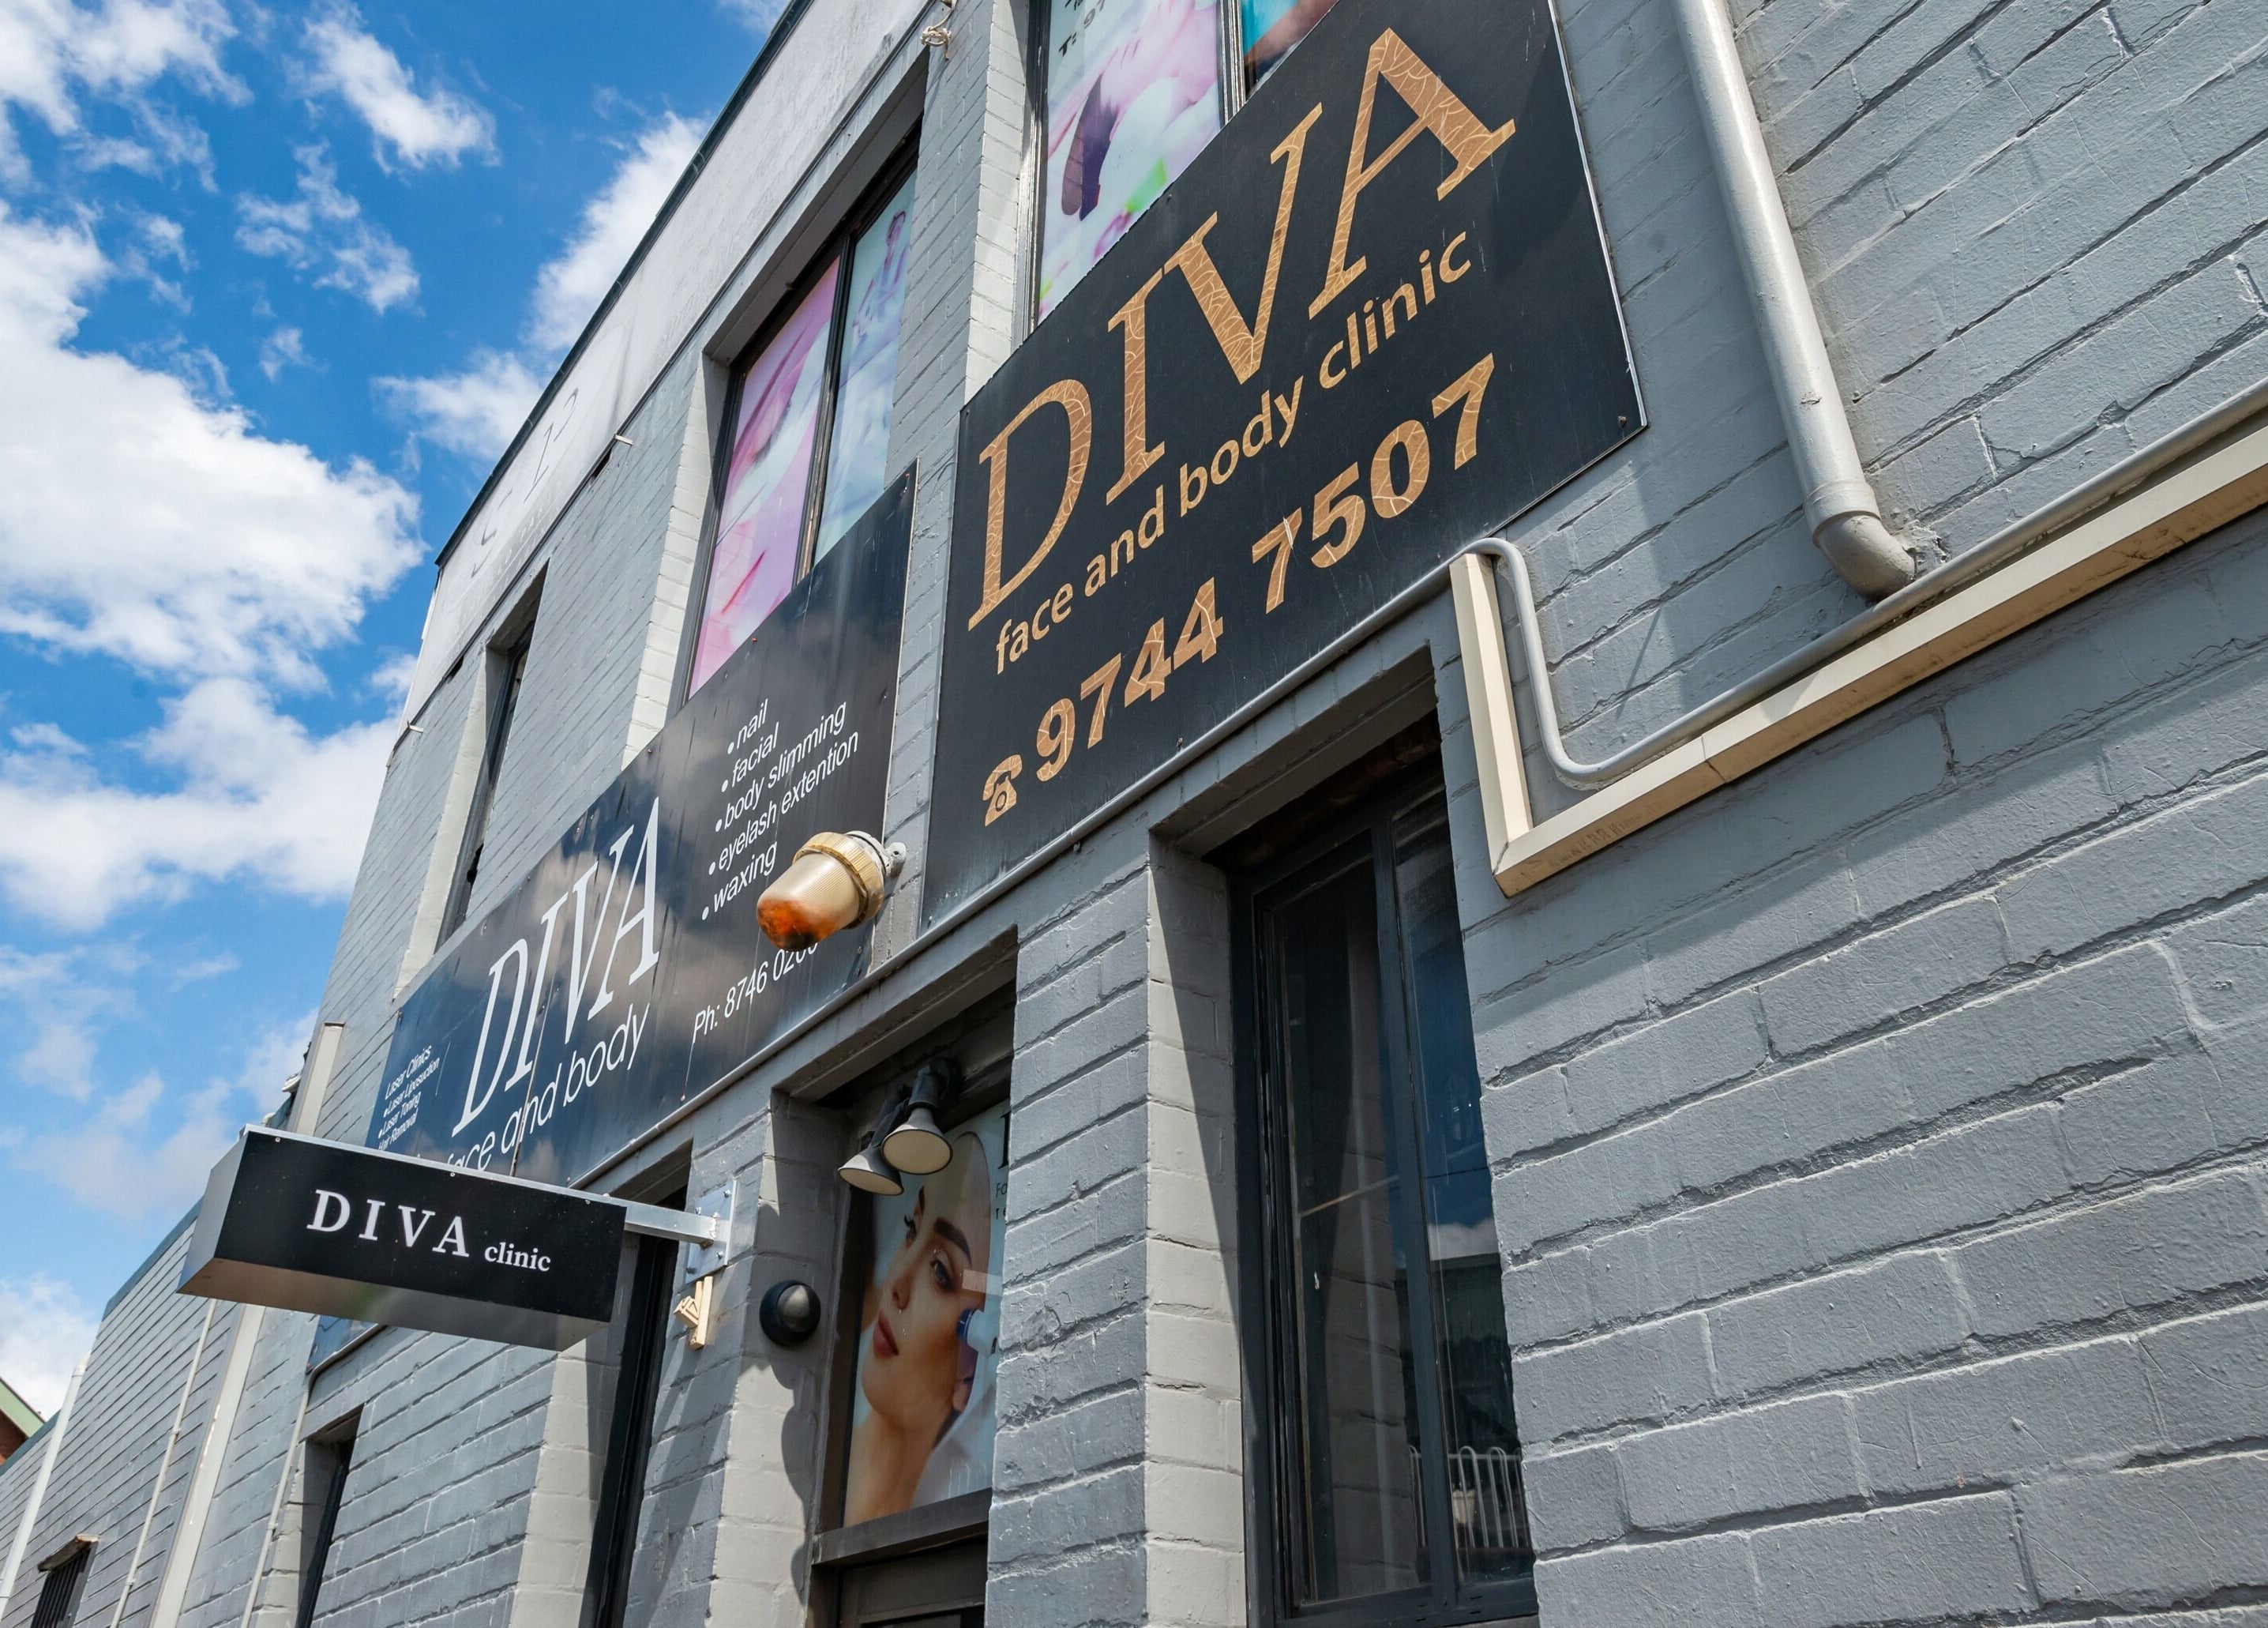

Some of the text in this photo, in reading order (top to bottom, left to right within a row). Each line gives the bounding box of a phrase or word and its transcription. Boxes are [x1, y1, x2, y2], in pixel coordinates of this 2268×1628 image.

[968, 27, 1516, 631] DIVA
[997, 231, 1472, 675] face and body clinic
[1036, 352, 1495, 782] 9744 7507
[723, 701, 847, 831] body slimming
[731, 721, 779, 788] facial
[737, 697, 768, 749] nail
[718, 730, 859, 870] eyelash extention
[713, 841, 778, 914] waxing
[452, 796, 660, 1137] DIVA
[692, 1005, 720, 1043] Ph:
[723, 961, 768, 1019] 8746
[501, 1062, 562, 1154] and
[563, 1002, 650, 1107] body
[306, 1189, 551, 1272] DIVA clinic
